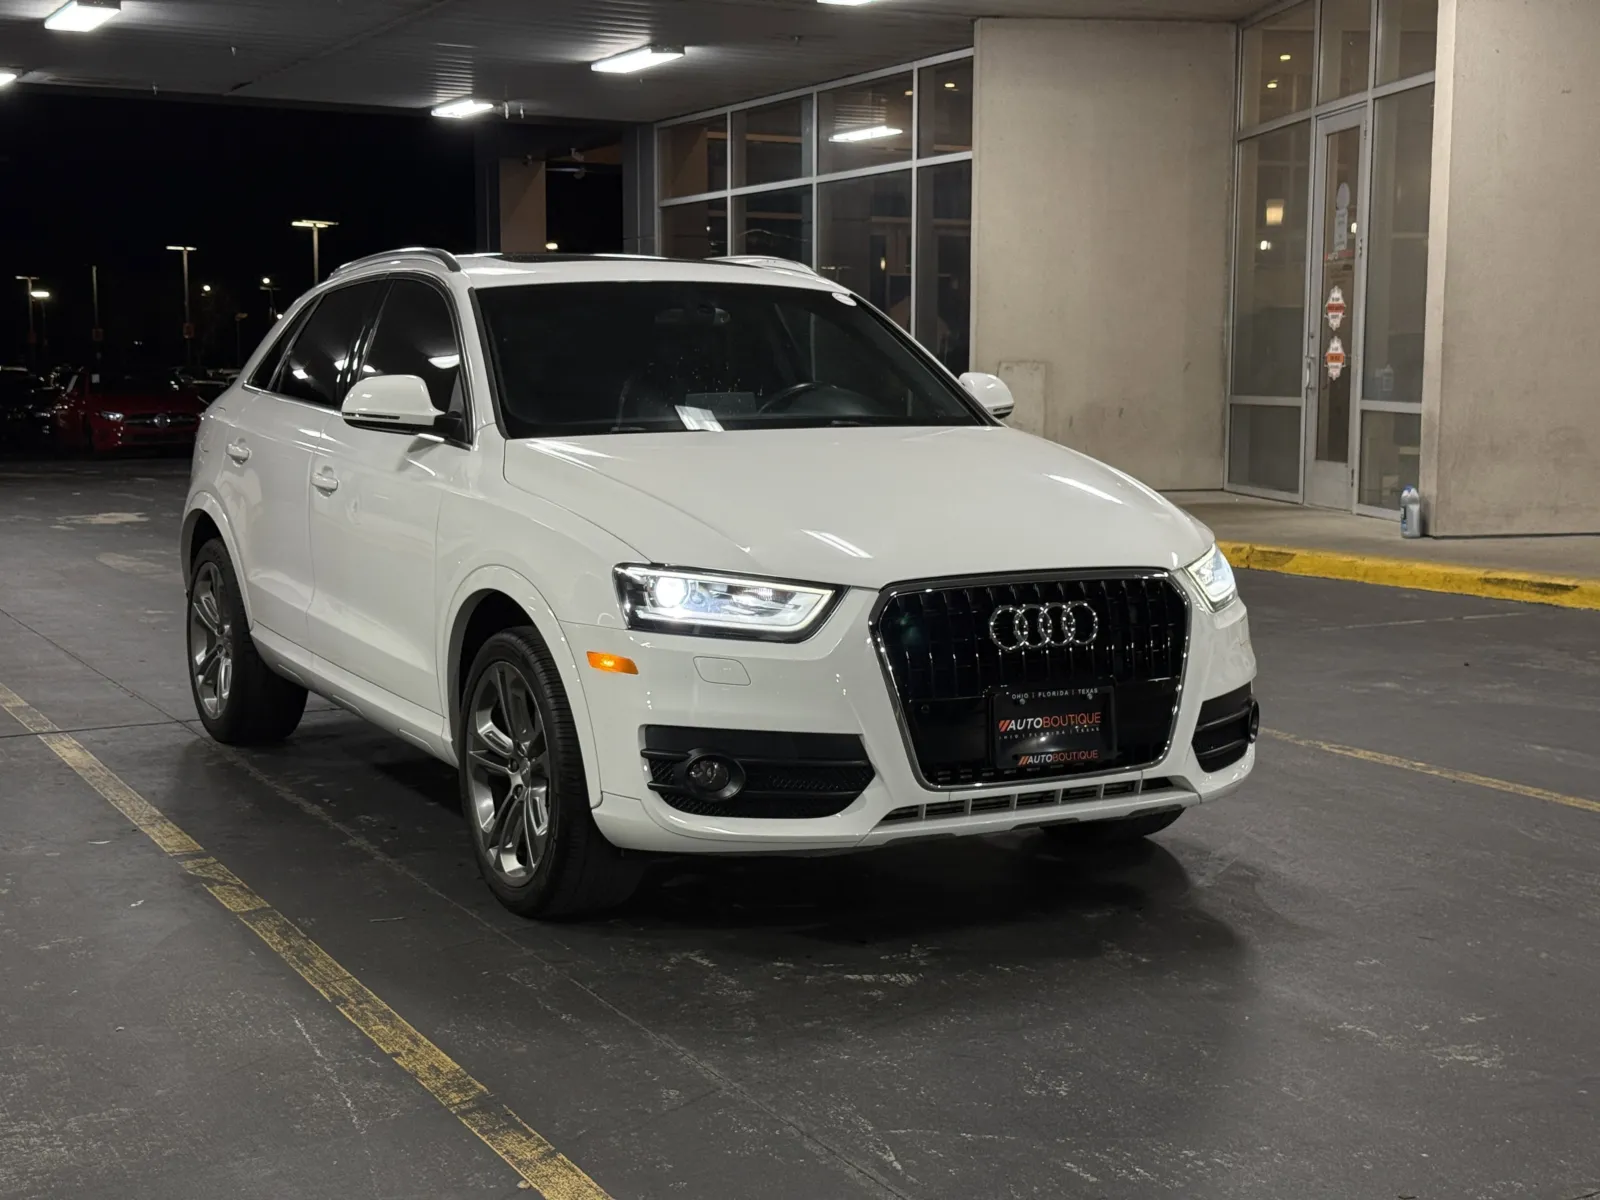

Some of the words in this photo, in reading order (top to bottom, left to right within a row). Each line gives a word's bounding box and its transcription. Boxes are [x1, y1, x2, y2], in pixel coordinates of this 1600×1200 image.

[1038, 690, 1069, 698] FLORIDA
[1006, 712, 1101, 731] AUTOBOUTIQUE
[1027, 750, 1098, 764] AUTOBOUTIQUE
